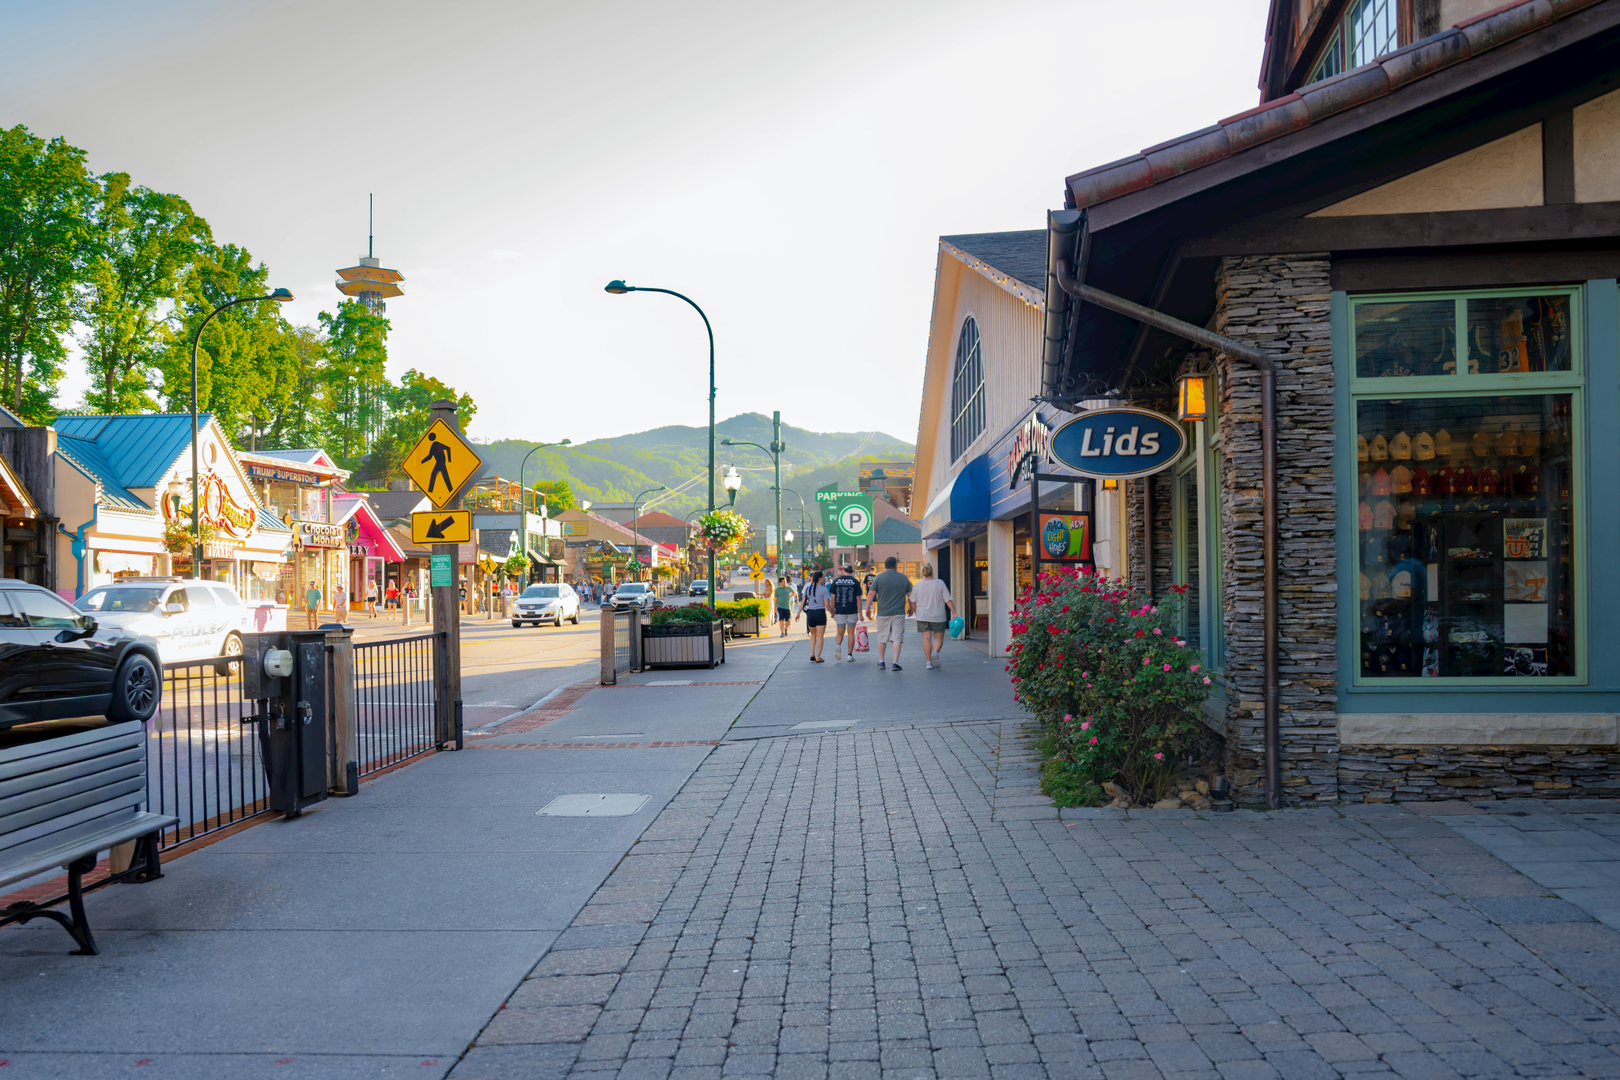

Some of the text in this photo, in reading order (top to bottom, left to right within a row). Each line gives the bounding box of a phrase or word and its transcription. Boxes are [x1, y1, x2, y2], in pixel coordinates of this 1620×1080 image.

[1499, 347, 1521, 372] 32
[1080, 426, 1160, 457] Lids
[252, 466, 318, 484] TRUMP SUPERSTORE
[850, 513, 863, 529] P
[1047, 520, 1066, 532] BLACK
[1069, 518, 1085, 531] NEW
[303, 524, 343, 537] Chocolate
[311, 535, 343, 548] Monkey
[1049, 541, 1067, 555] HOLES
[171, 622, 218, 640] POLICE
